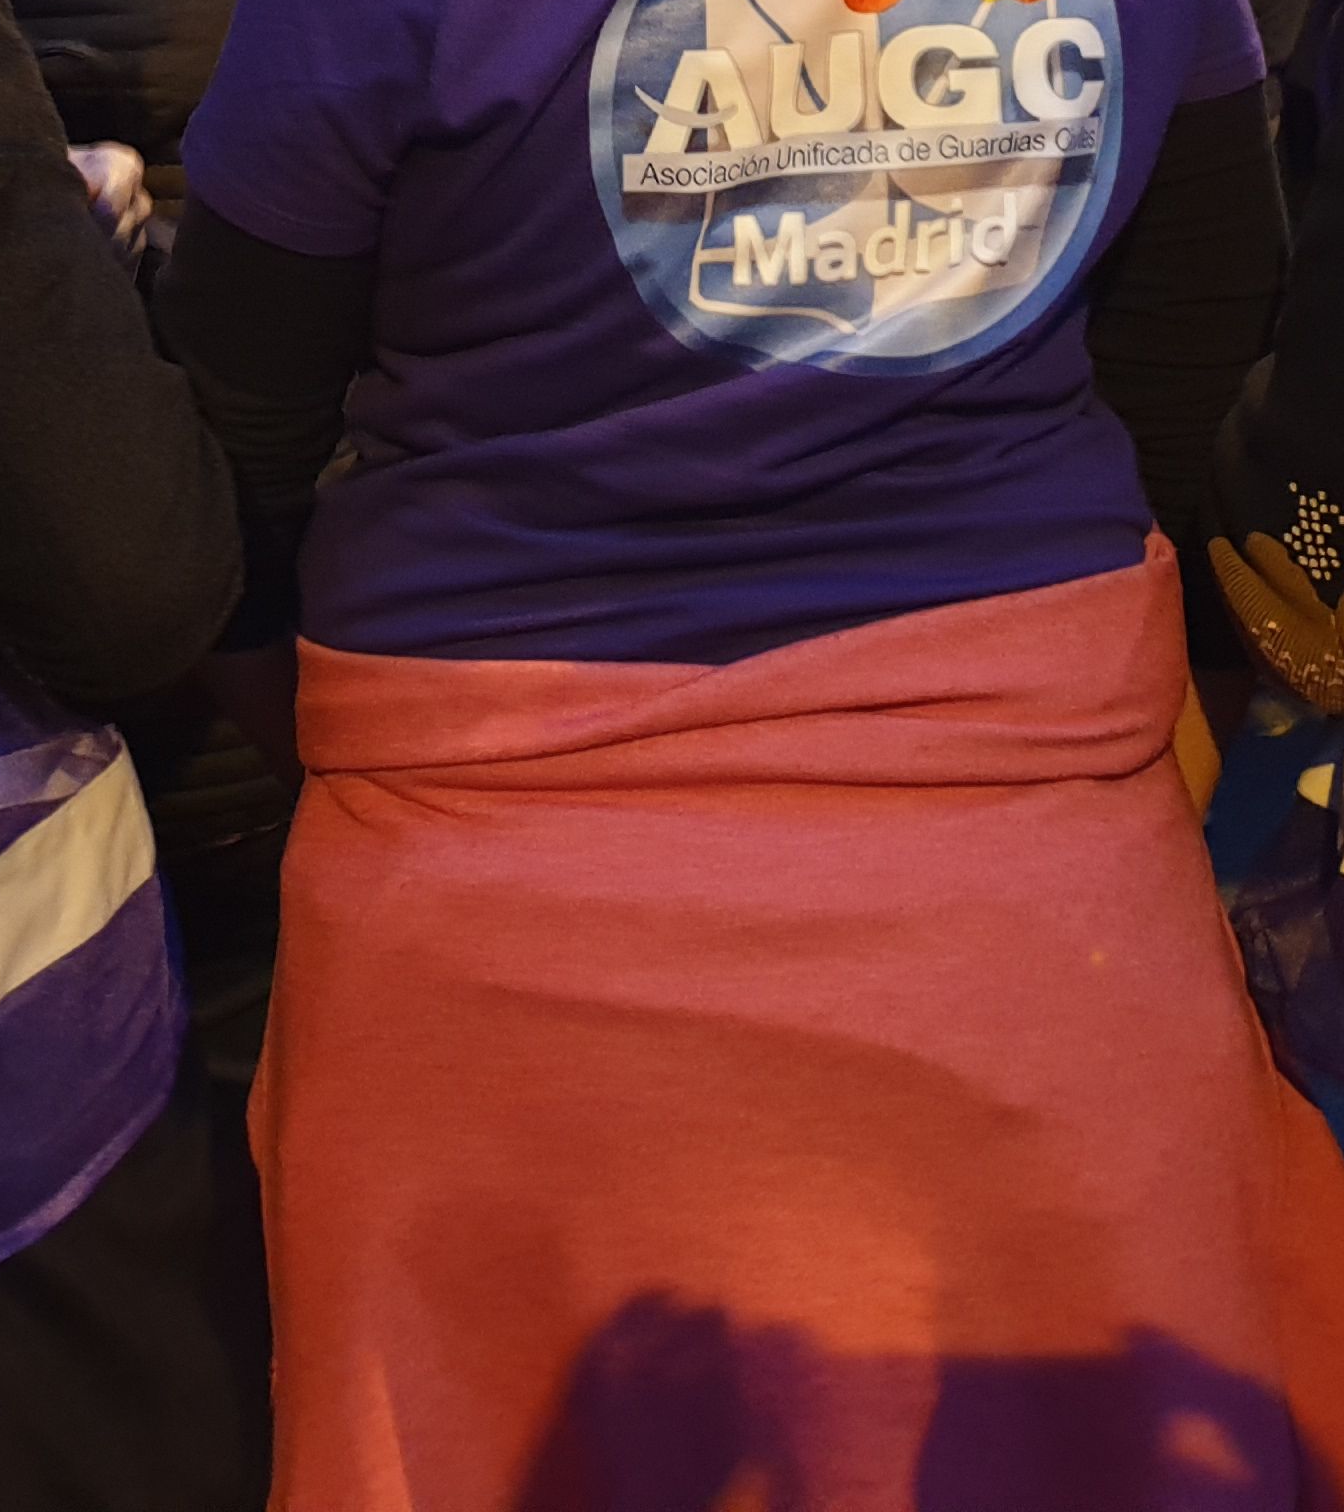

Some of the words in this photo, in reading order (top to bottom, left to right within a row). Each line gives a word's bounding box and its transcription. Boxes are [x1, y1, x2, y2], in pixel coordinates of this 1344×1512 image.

[637, 17, 1105, 155] AUGC
[640, 152, 770, 188] Asociación
[776, 138, 889, 171] Unificada
[898, 136, 931, 161] de
[939, 129, 1046, 160] Guardias
[732, 191, 1018, 286] Madrid
